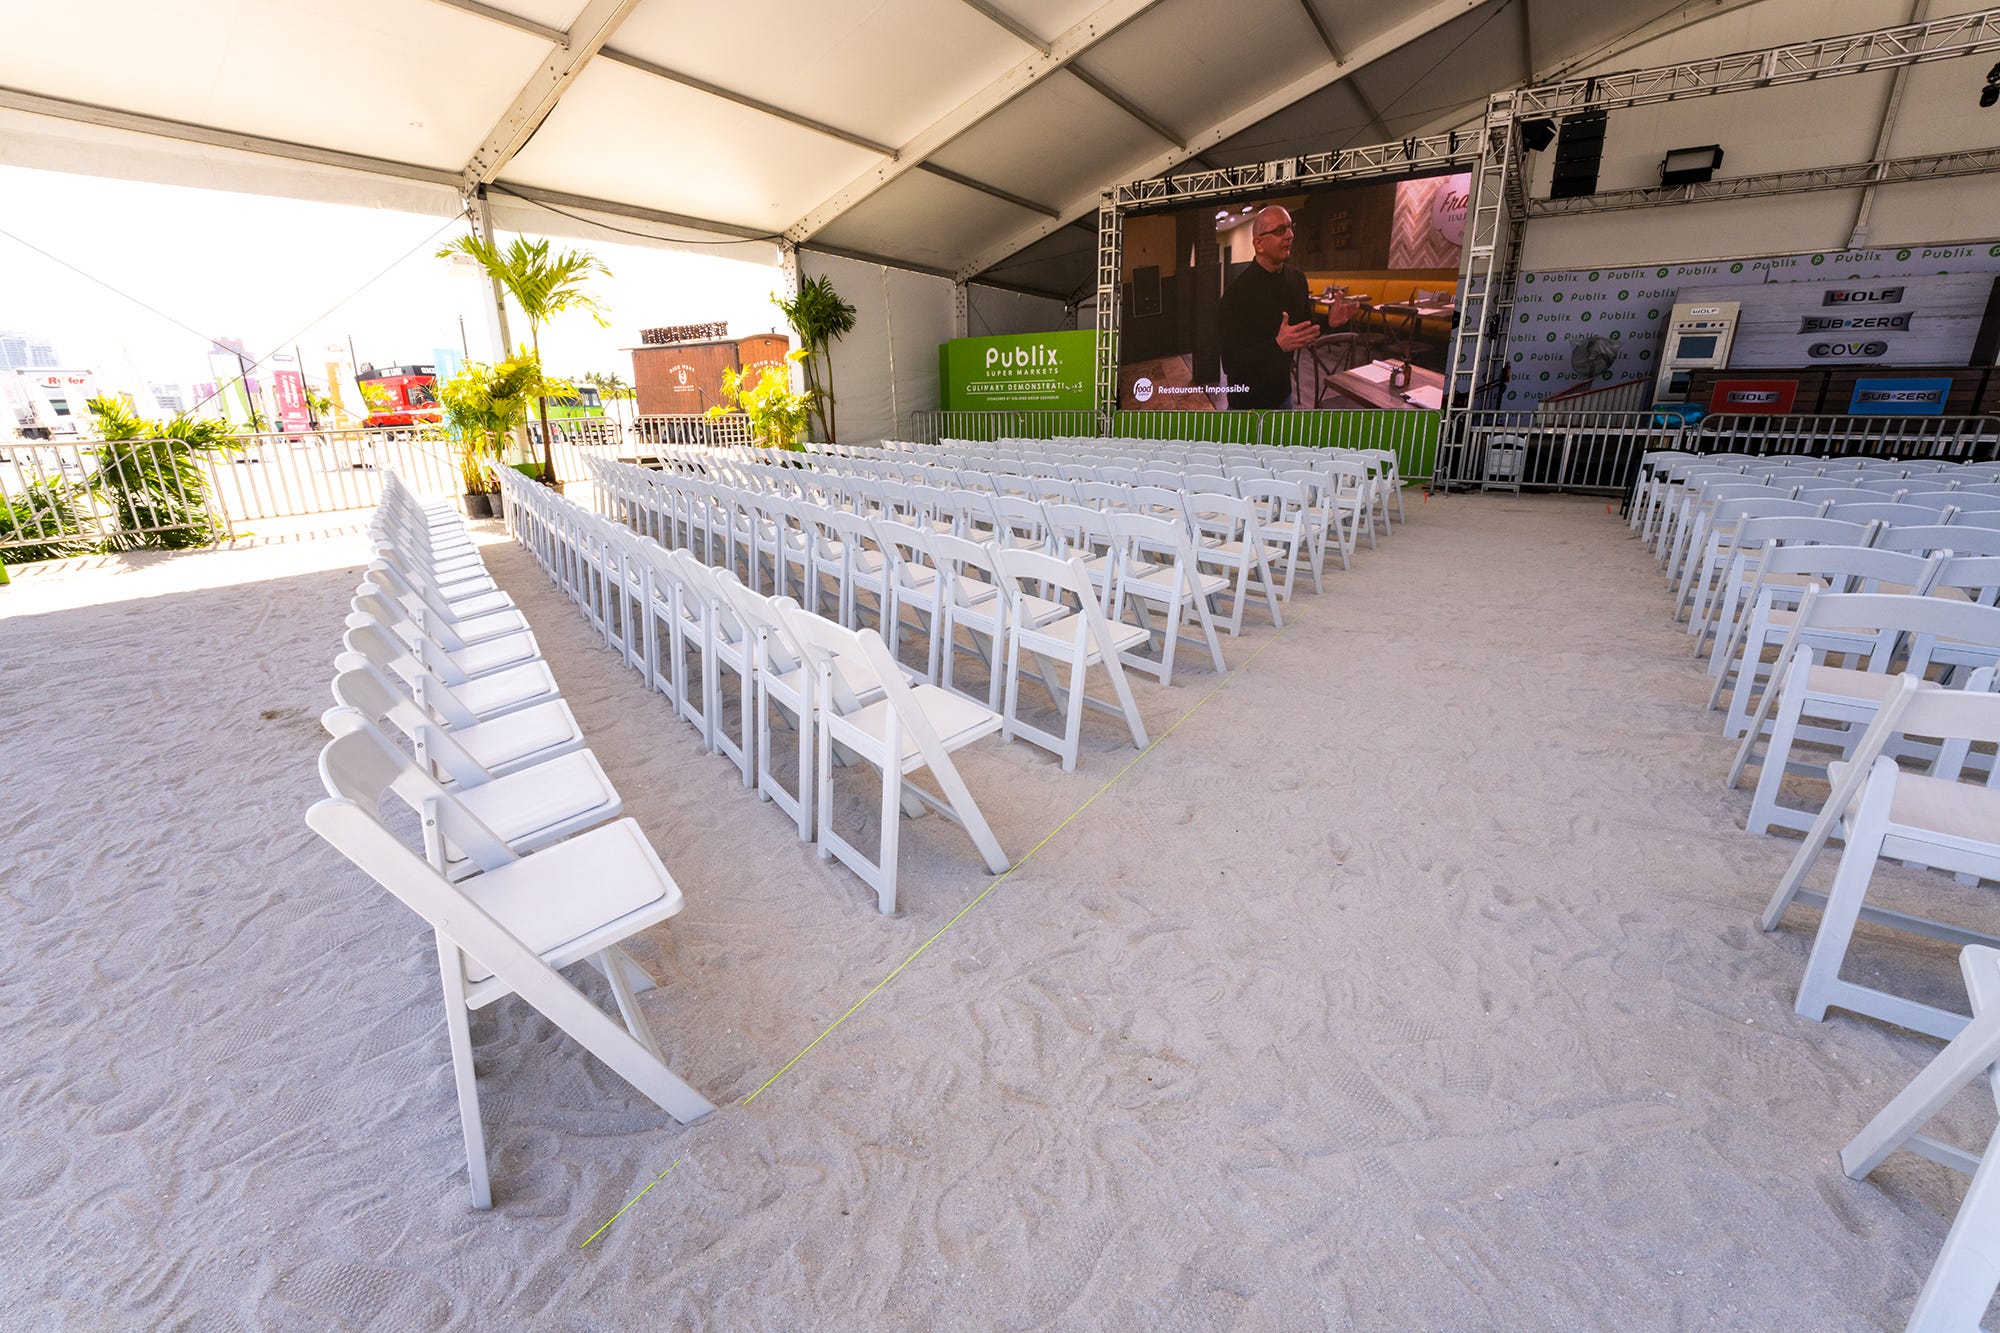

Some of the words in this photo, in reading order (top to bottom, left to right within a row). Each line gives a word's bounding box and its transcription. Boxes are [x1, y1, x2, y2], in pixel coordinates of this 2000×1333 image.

[1543, 274, 1577, 282] Publix
[1608, 271, 1646, 279] Publix
[1678, 266, 1718, 275] Publix
[1752, 259, 1797, 271] Publix
[1835, 251, 1881, 263] Publix
[1922, 248, 1973, 259] Publix
[1517, 294, 1542, 302] ublix
[1571, 292, 1606, 301] Publix
[1638, 289, 1675, 298] Publix
[1830, 290, 1896, 302] WOLF
[1537, 313, 1571, 321] Publix
[1600, 311, 1636, 320] Publix
[1512, 334, 1536, 342] ublix
[1816, 344, 1879, 355] COVE
[986, 344, 1058, 368] Publix
[966, 384, 1004, 392] CULINARY
[1008, 382, 1082, 391] DEMONSTRATIS
[1134, 383, 1152, 396] food
[1158, 386, 1204, 394] Restaurant:
[1206, 384, 1250, 395] Impossible
